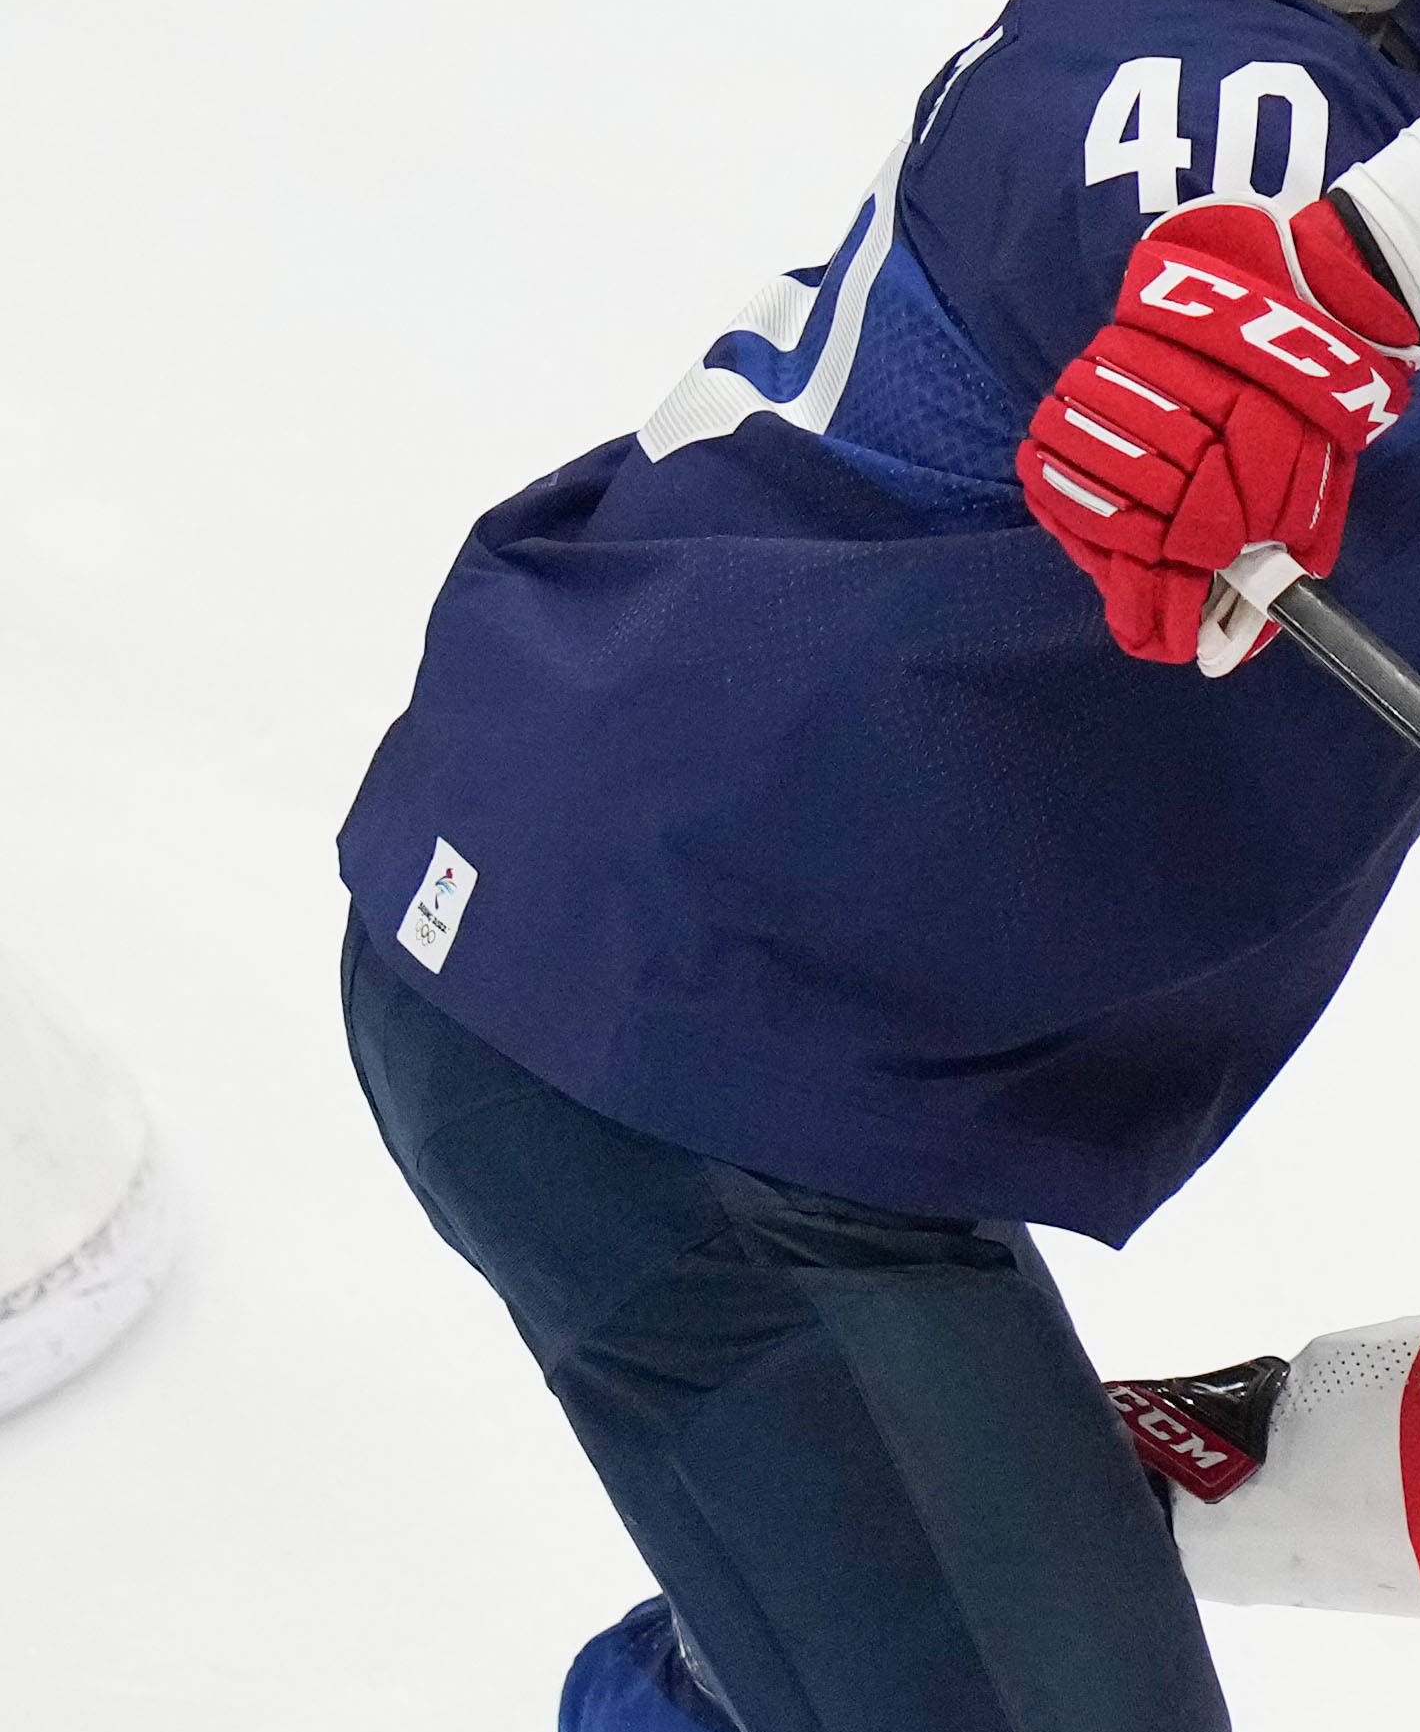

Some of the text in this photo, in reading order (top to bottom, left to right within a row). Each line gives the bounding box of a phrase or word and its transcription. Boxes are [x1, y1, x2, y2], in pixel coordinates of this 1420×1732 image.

[1083, 56, 1329, 214] 40
[1138, 258, 1400, 445] CCM
[1107, 1384, 1228, 1469] CCM
